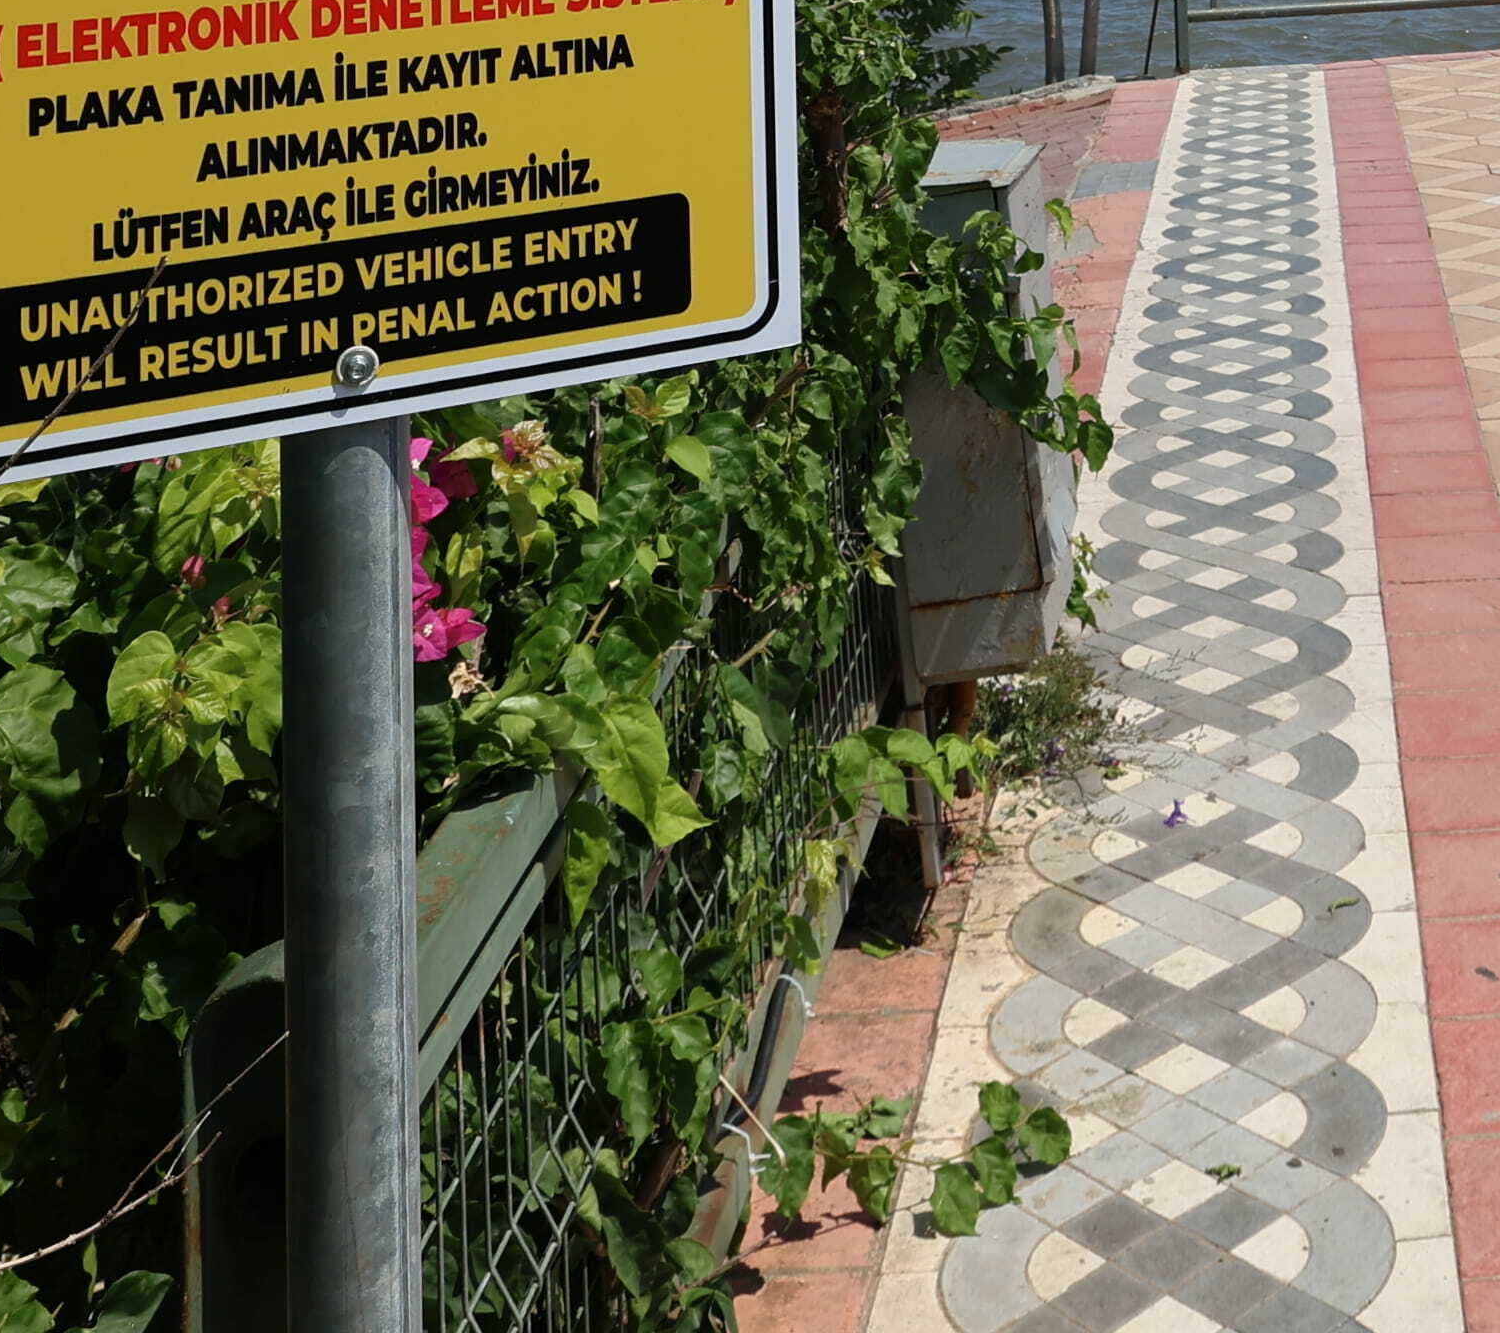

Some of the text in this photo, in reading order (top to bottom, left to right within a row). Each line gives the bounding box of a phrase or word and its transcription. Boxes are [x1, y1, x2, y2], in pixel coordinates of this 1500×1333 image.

[29, 34, 634, 136] PLAKA TANIMA İLE KAYIT ALTINA
[93, 147, 600, 261] LÜTFEN ARAÇ İLE GİRMEYİNİZ.
[197, 113, 487, 183] ALINMAKTADIR.
[20, 218, 637, 342] UNAUTHORIZED VEHICLE ENTRY
[20, 353, 126, 401] WILL
[139, 325, 288, 382] RESULT
[301, 318, 338, 355] IN
[352, 297, 476, 347] PENAL
[487, 273, 621, 325] ACTION
